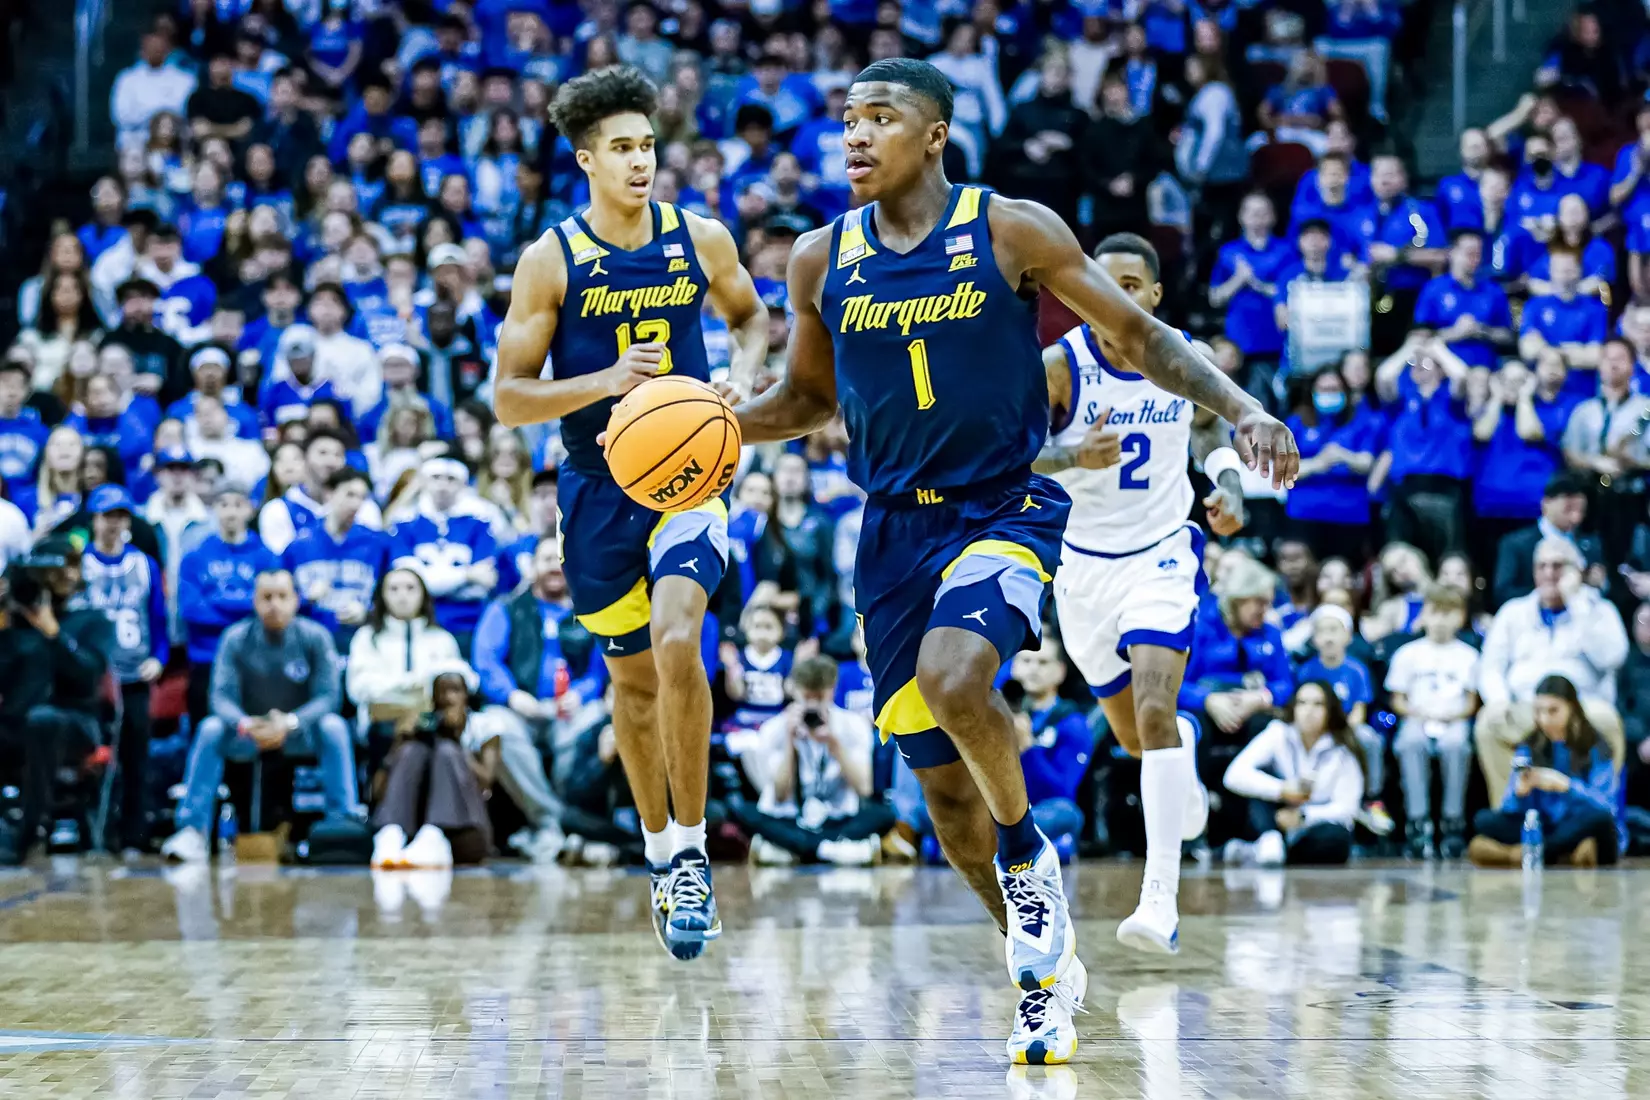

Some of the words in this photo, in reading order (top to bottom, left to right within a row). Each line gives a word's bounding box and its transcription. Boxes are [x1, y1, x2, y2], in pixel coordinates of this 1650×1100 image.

[580, 276, 698, 318] Marquette
[839, 281, 987, 336] Marquette
[907, 338, 936, 410] 1
[1084, 401, 1135, 425] Ston
[1138, 399, 1186, 424] Hall
[648, 458, 704, 504] NCAA
[1119, 432, 1151, 490] 2
[106, 608, 141, 649] 6
